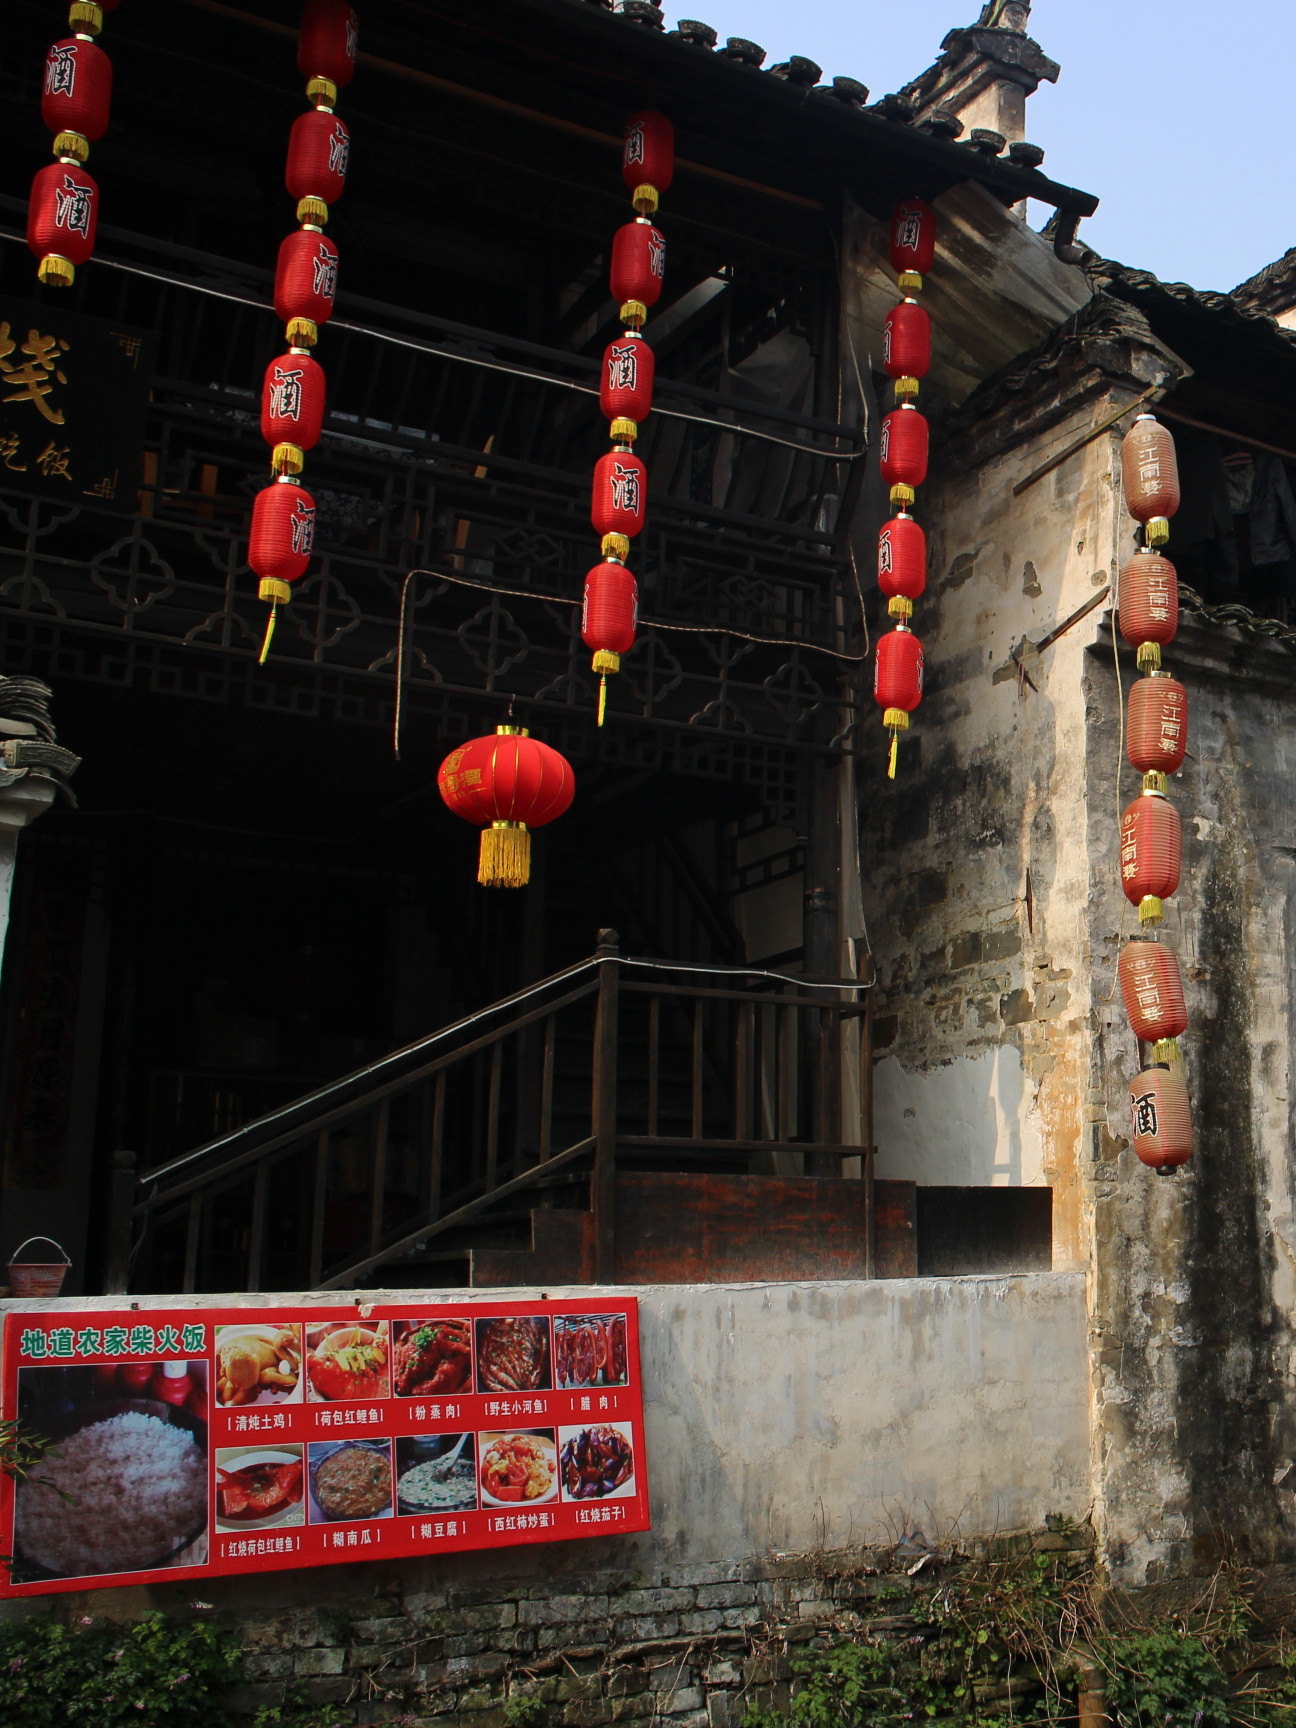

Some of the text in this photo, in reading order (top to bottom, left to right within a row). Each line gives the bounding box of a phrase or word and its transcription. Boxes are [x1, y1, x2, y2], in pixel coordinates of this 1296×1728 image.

[45, 45, 78, 97] 酒
[56, 174, 93, 239] 酒
[896, 207, 922, 251] 酒
[608, 344, 637, 392] 酒
[269, 366, 304, 422] 酒
[611, 465, 640, 518] 酒
[1130, 1091, 1158, 1138] 酒
[20, 1323, 206, 1358] 地道农家柴火饭
[415, 1404, 455, 1420] 粉蒸肉
[489, 1399, 543, 1416] 野生小河鱼
[580, 1394, 610, 1411] 腊肉
[235, 1412, 285, 1432] 清炖土鸡
[320, 1408, 379, 1427] 荷包红鲤鱼
[494, 1512, 549, 1532] 西红柿炒蛋
[580, 1506, 622, 1523] 红烧茄子
[332, 1529, 372, 1548] 糊南瓜
[420, 1521, 458, 1539] 糊豆腐
[228, 1535, 294, 1557] 红烧荷包红鲤鱼
